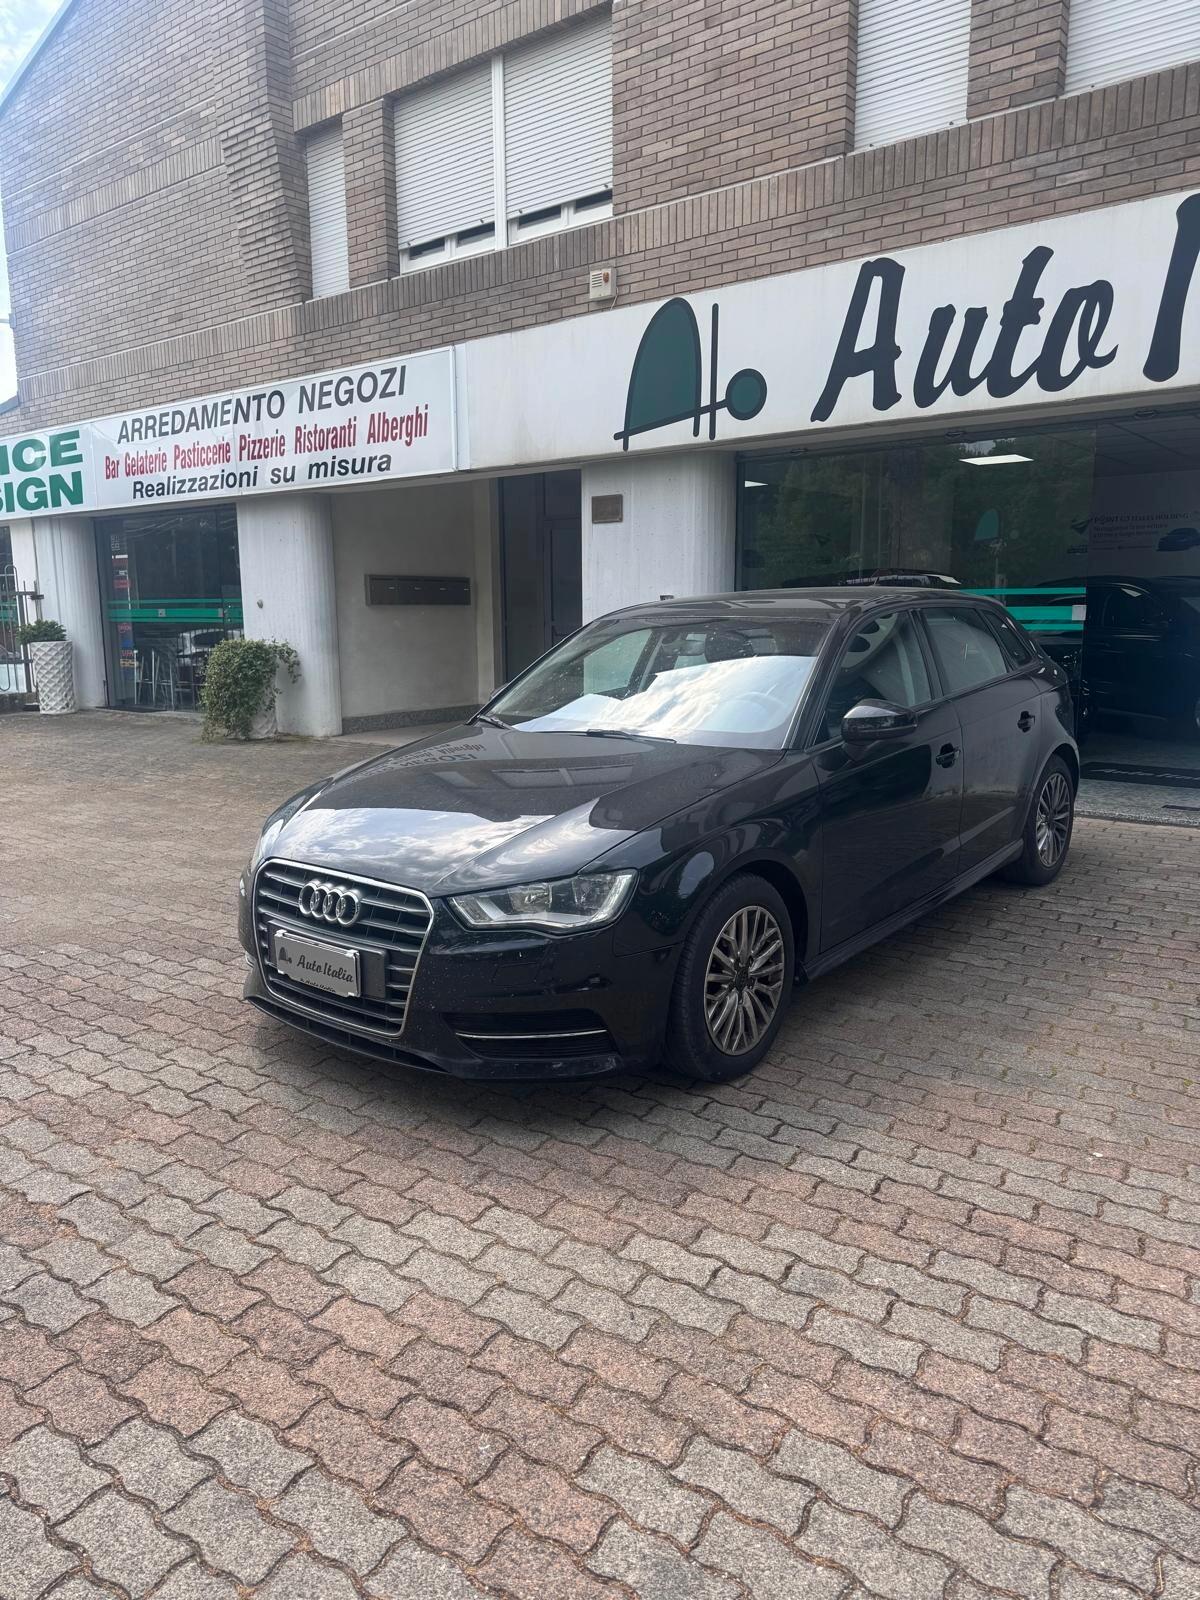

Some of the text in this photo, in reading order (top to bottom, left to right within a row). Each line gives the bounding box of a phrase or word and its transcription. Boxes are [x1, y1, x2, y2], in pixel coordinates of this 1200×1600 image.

[810, 246, 1118, 422] Auto
[105, 404, 429, 480] Bar Gelaterie Pasticcerie Pizzerie Ristoranti Alberghi
[117, 365, 407, 444] ARREDAMENTO NEGOZI
[132, 454, 392, 499] Realizzazioni su misura
